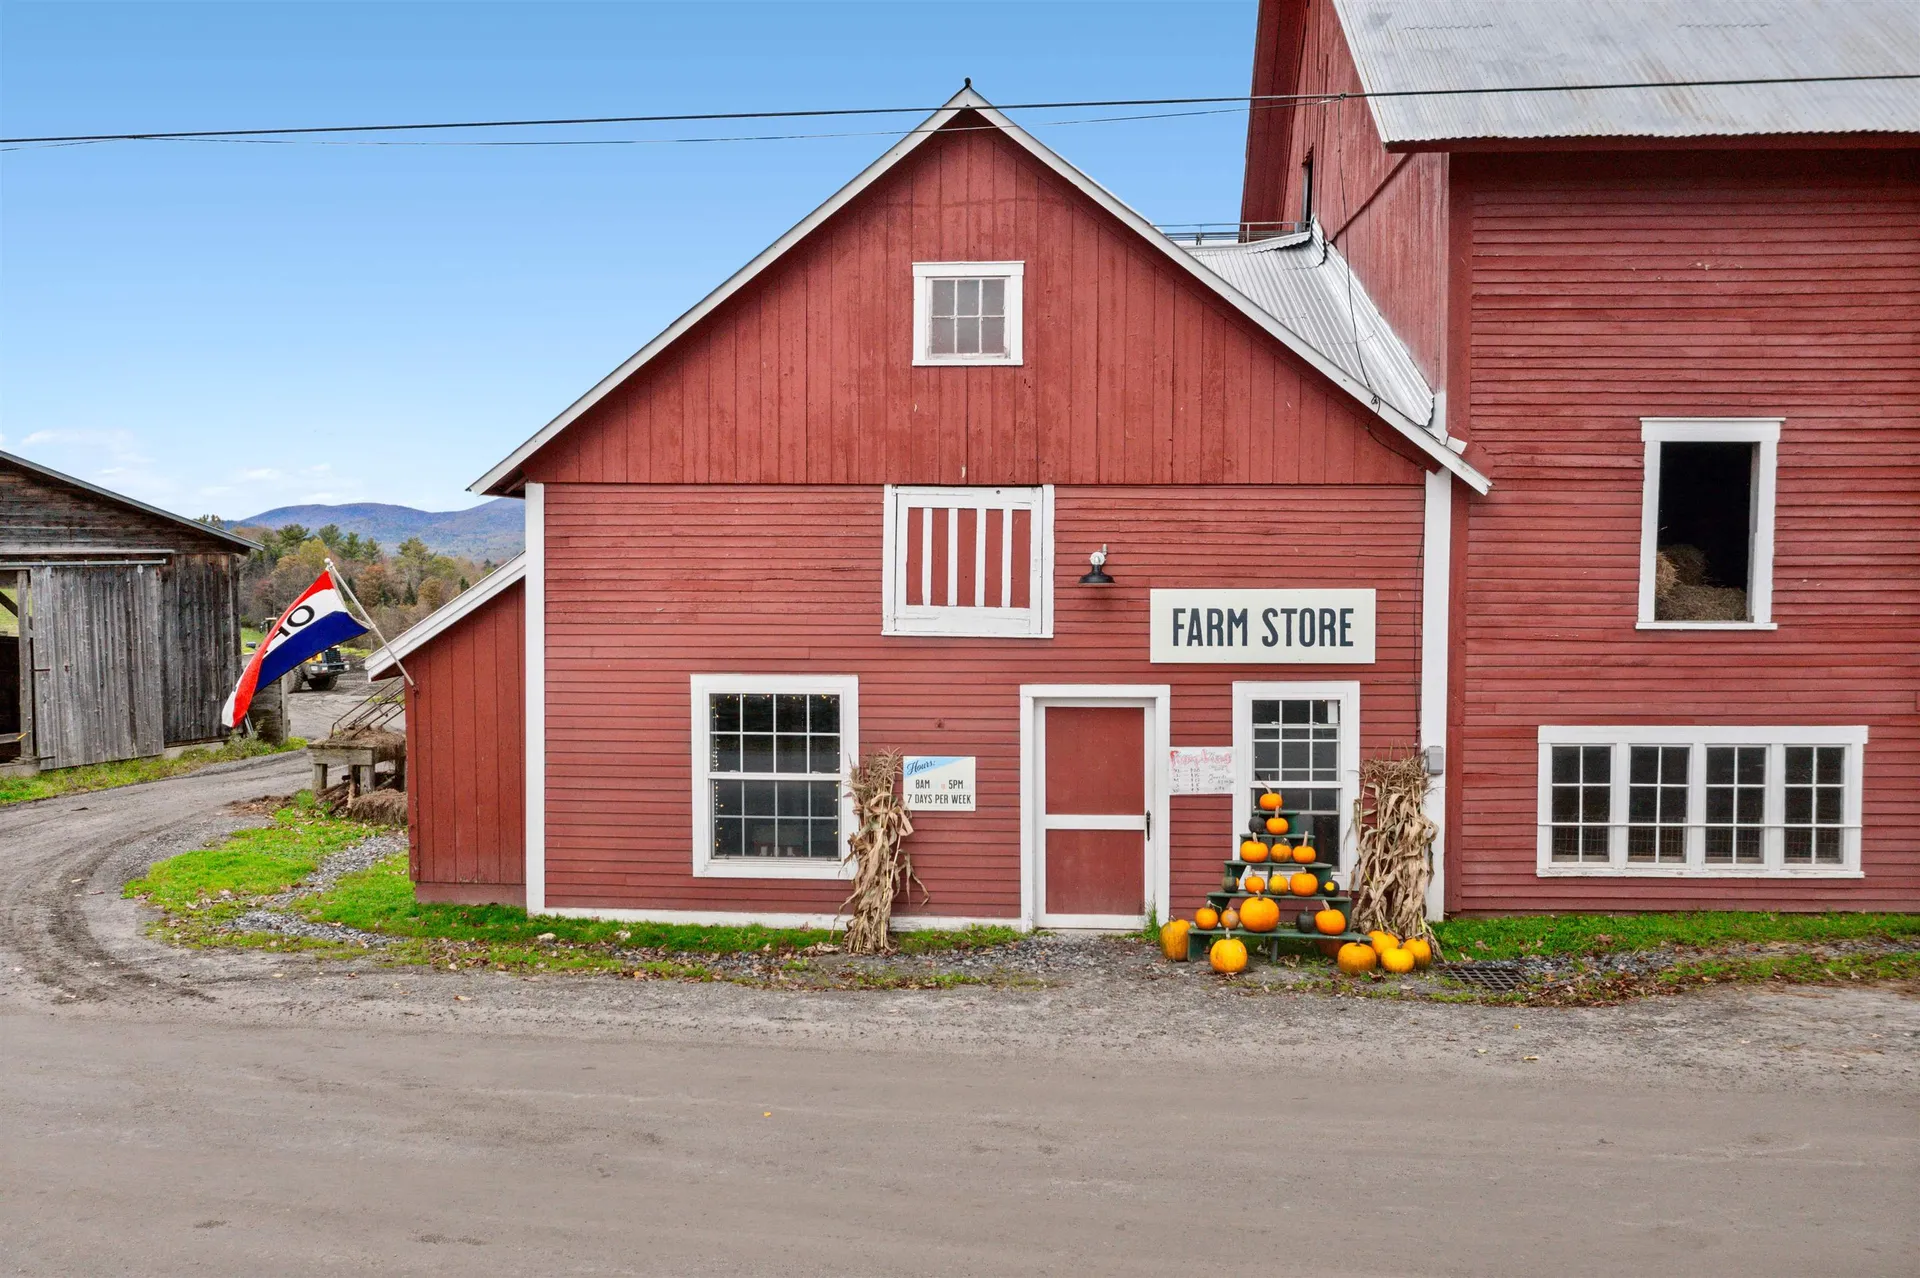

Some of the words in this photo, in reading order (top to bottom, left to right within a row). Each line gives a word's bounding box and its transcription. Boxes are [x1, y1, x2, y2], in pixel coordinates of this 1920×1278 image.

[1172, 607, 1248, 647] FARM
[1261, 607, 1354, 648] STORE
[906, 760, 936, 776] Hours:
[915, 779, 931, 789] 8AM
[948, 779, 964, 790] 5PM
[907, 794, 913, 804] 7
[914, 794, 933, 804] DAYS
[935, 794, 949, 805] PER
[951, 794, 972, 805] WEEK
